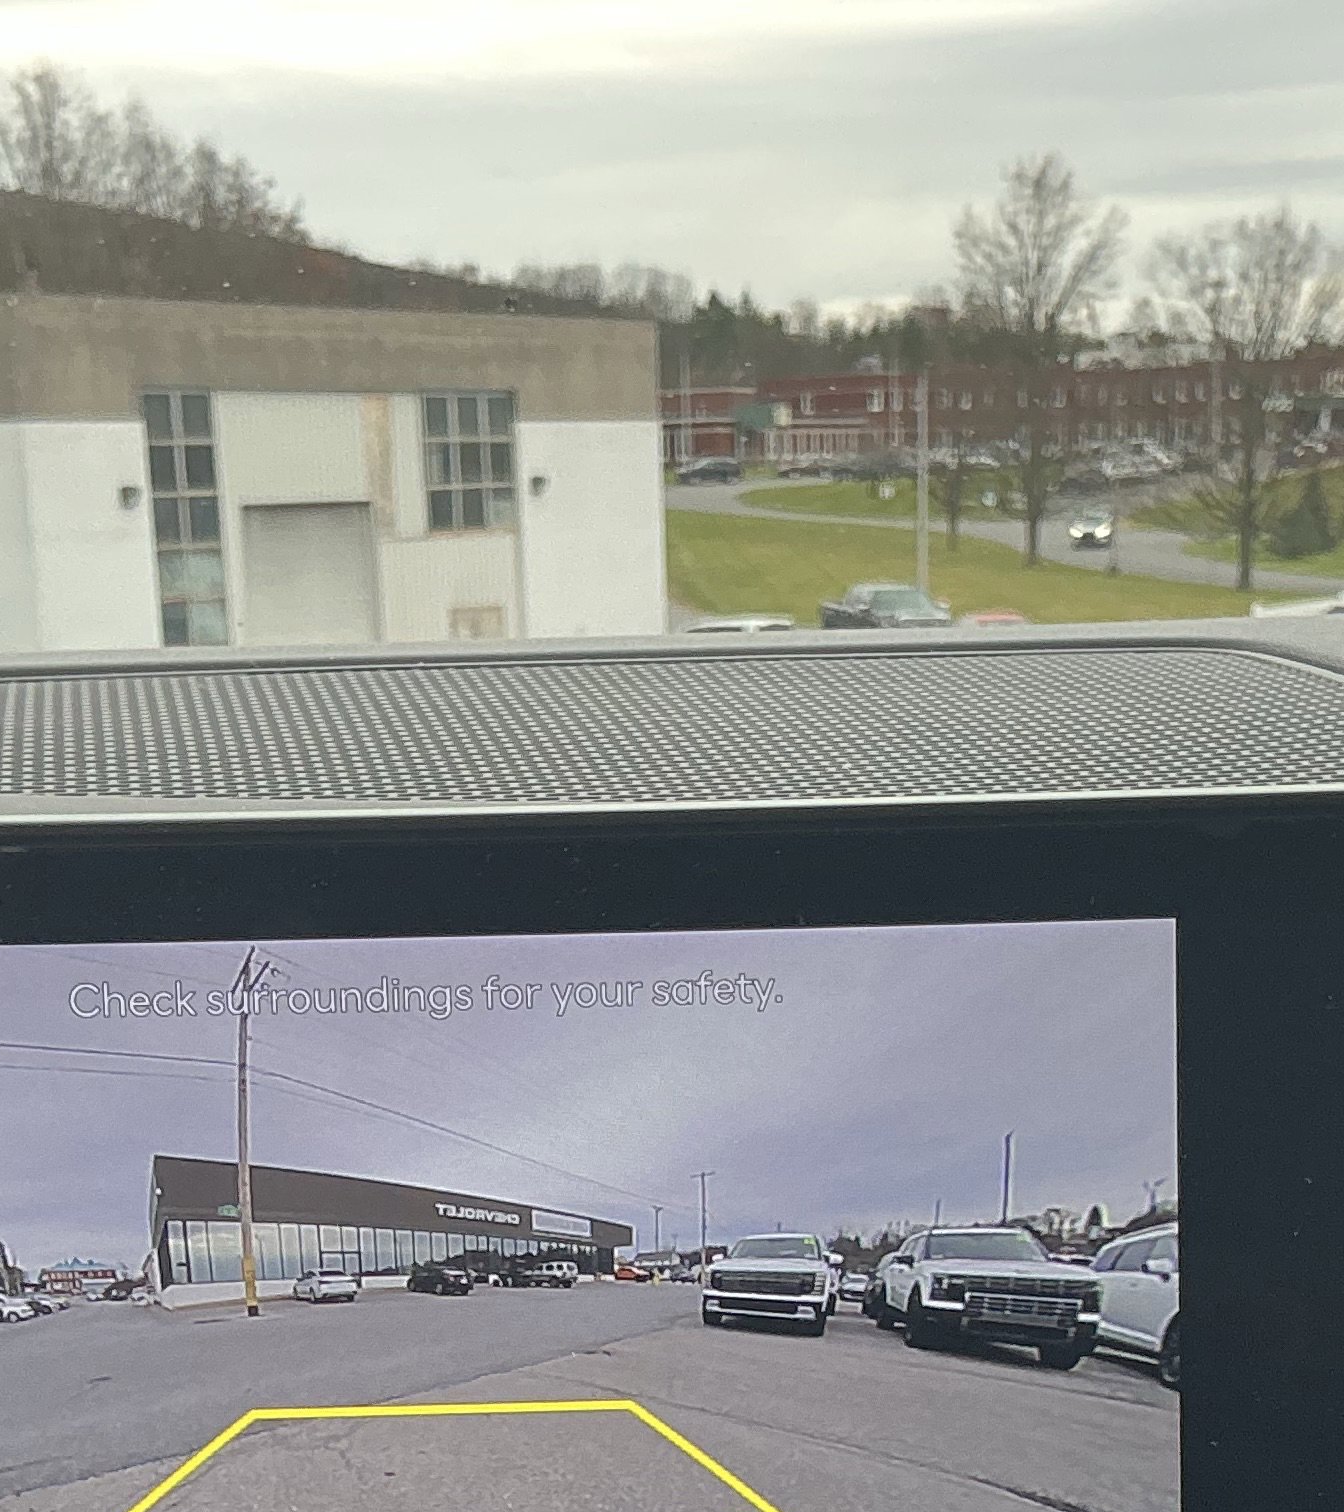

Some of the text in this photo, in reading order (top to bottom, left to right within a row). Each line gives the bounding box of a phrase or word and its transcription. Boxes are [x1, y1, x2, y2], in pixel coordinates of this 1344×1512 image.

[68, 969, 784, 1021] Check surroundings for your safety.
